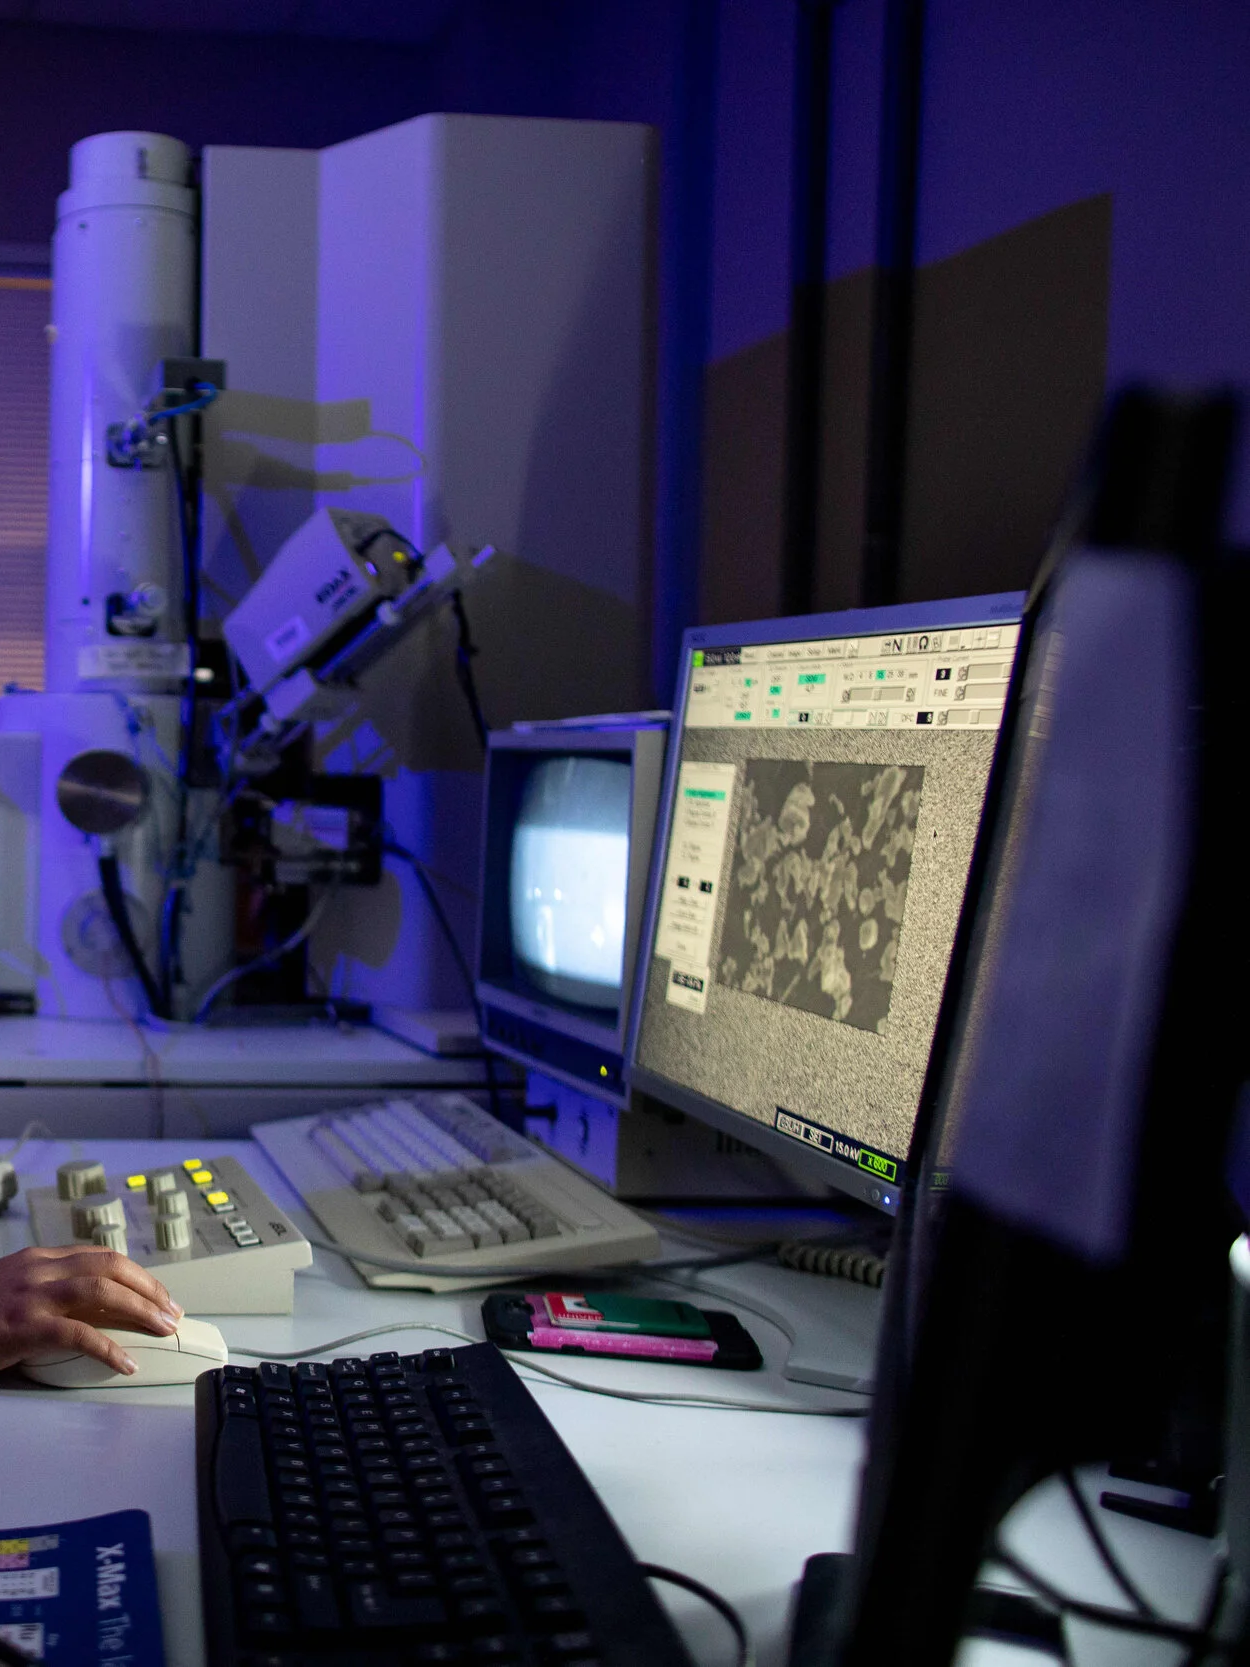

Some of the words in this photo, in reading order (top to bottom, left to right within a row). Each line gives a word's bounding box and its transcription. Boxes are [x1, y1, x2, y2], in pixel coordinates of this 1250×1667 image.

[933, 689, 948, 698] FINE
[809, 1128, 822, 1144] SEI
[97, 1611, 134, 1651] The
